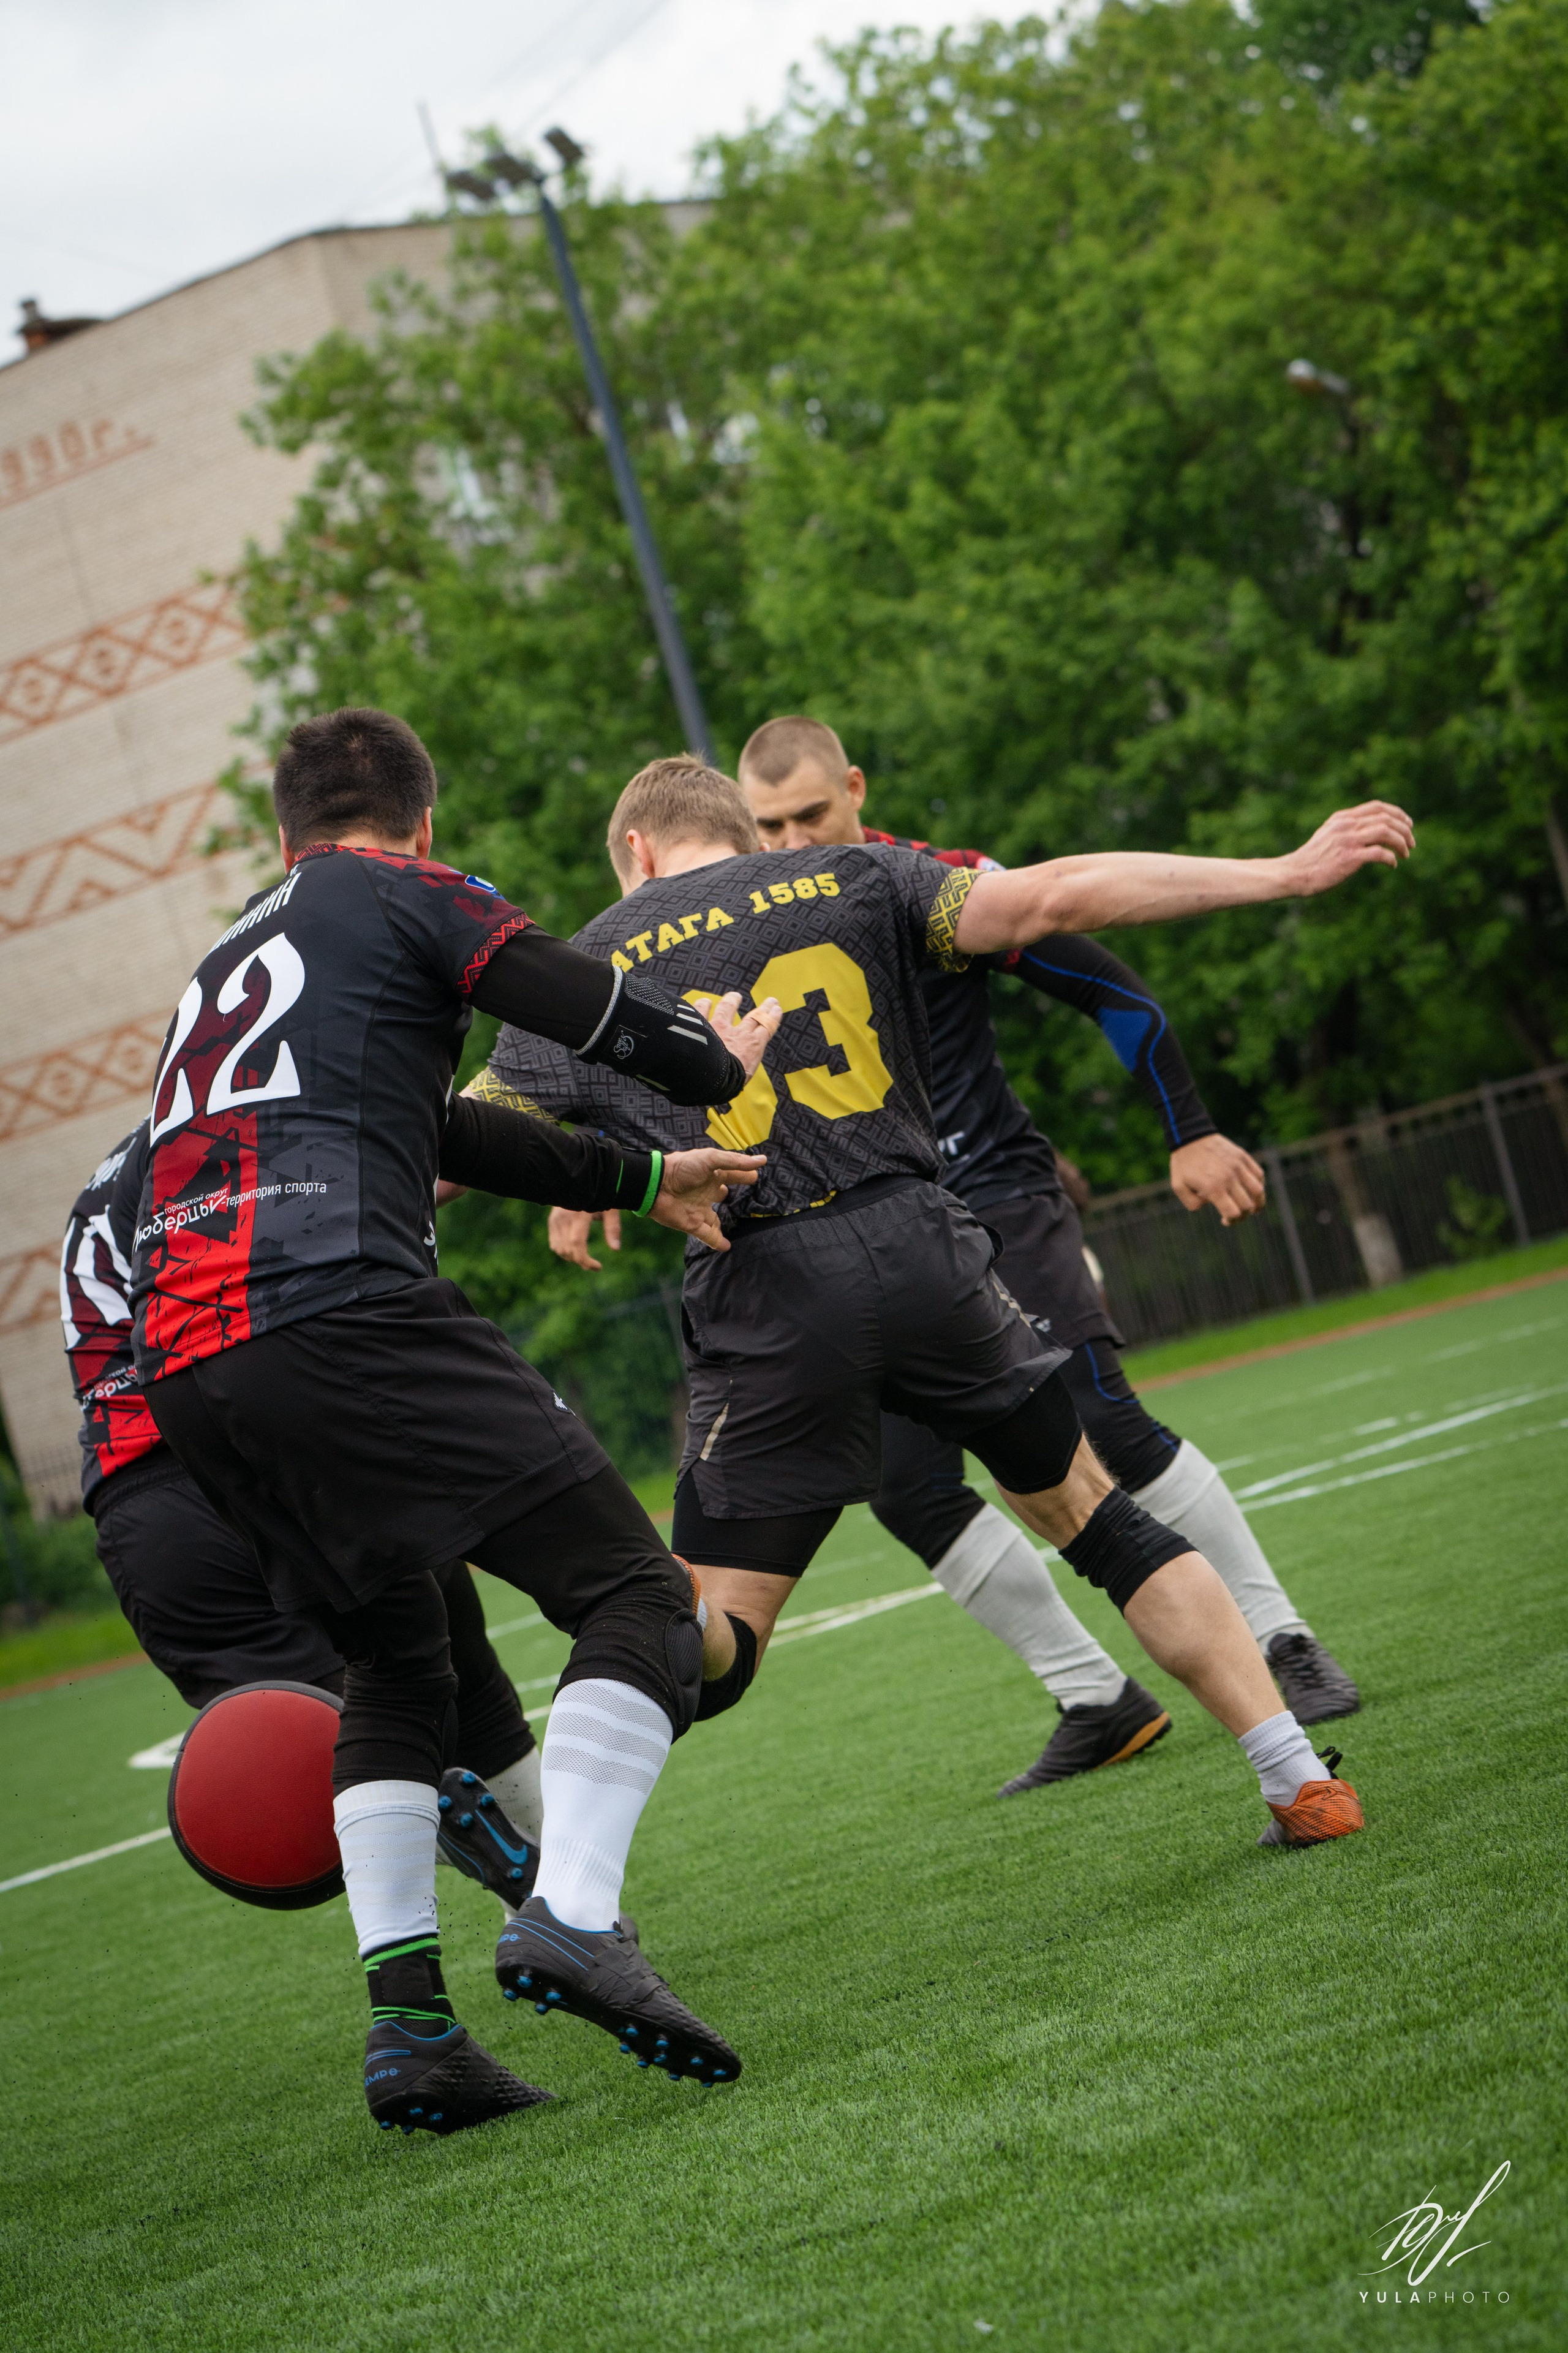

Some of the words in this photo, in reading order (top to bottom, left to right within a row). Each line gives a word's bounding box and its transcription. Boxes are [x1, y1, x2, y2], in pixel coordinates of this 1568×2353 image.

[749, 873, 840, 915] 1585
[150, 932, 305, 1148] 22
[164, 1193, 204, 1215] городской
[205, 1187, 228, 1202] округ
[285, 1182, 327, 1196] спорта
